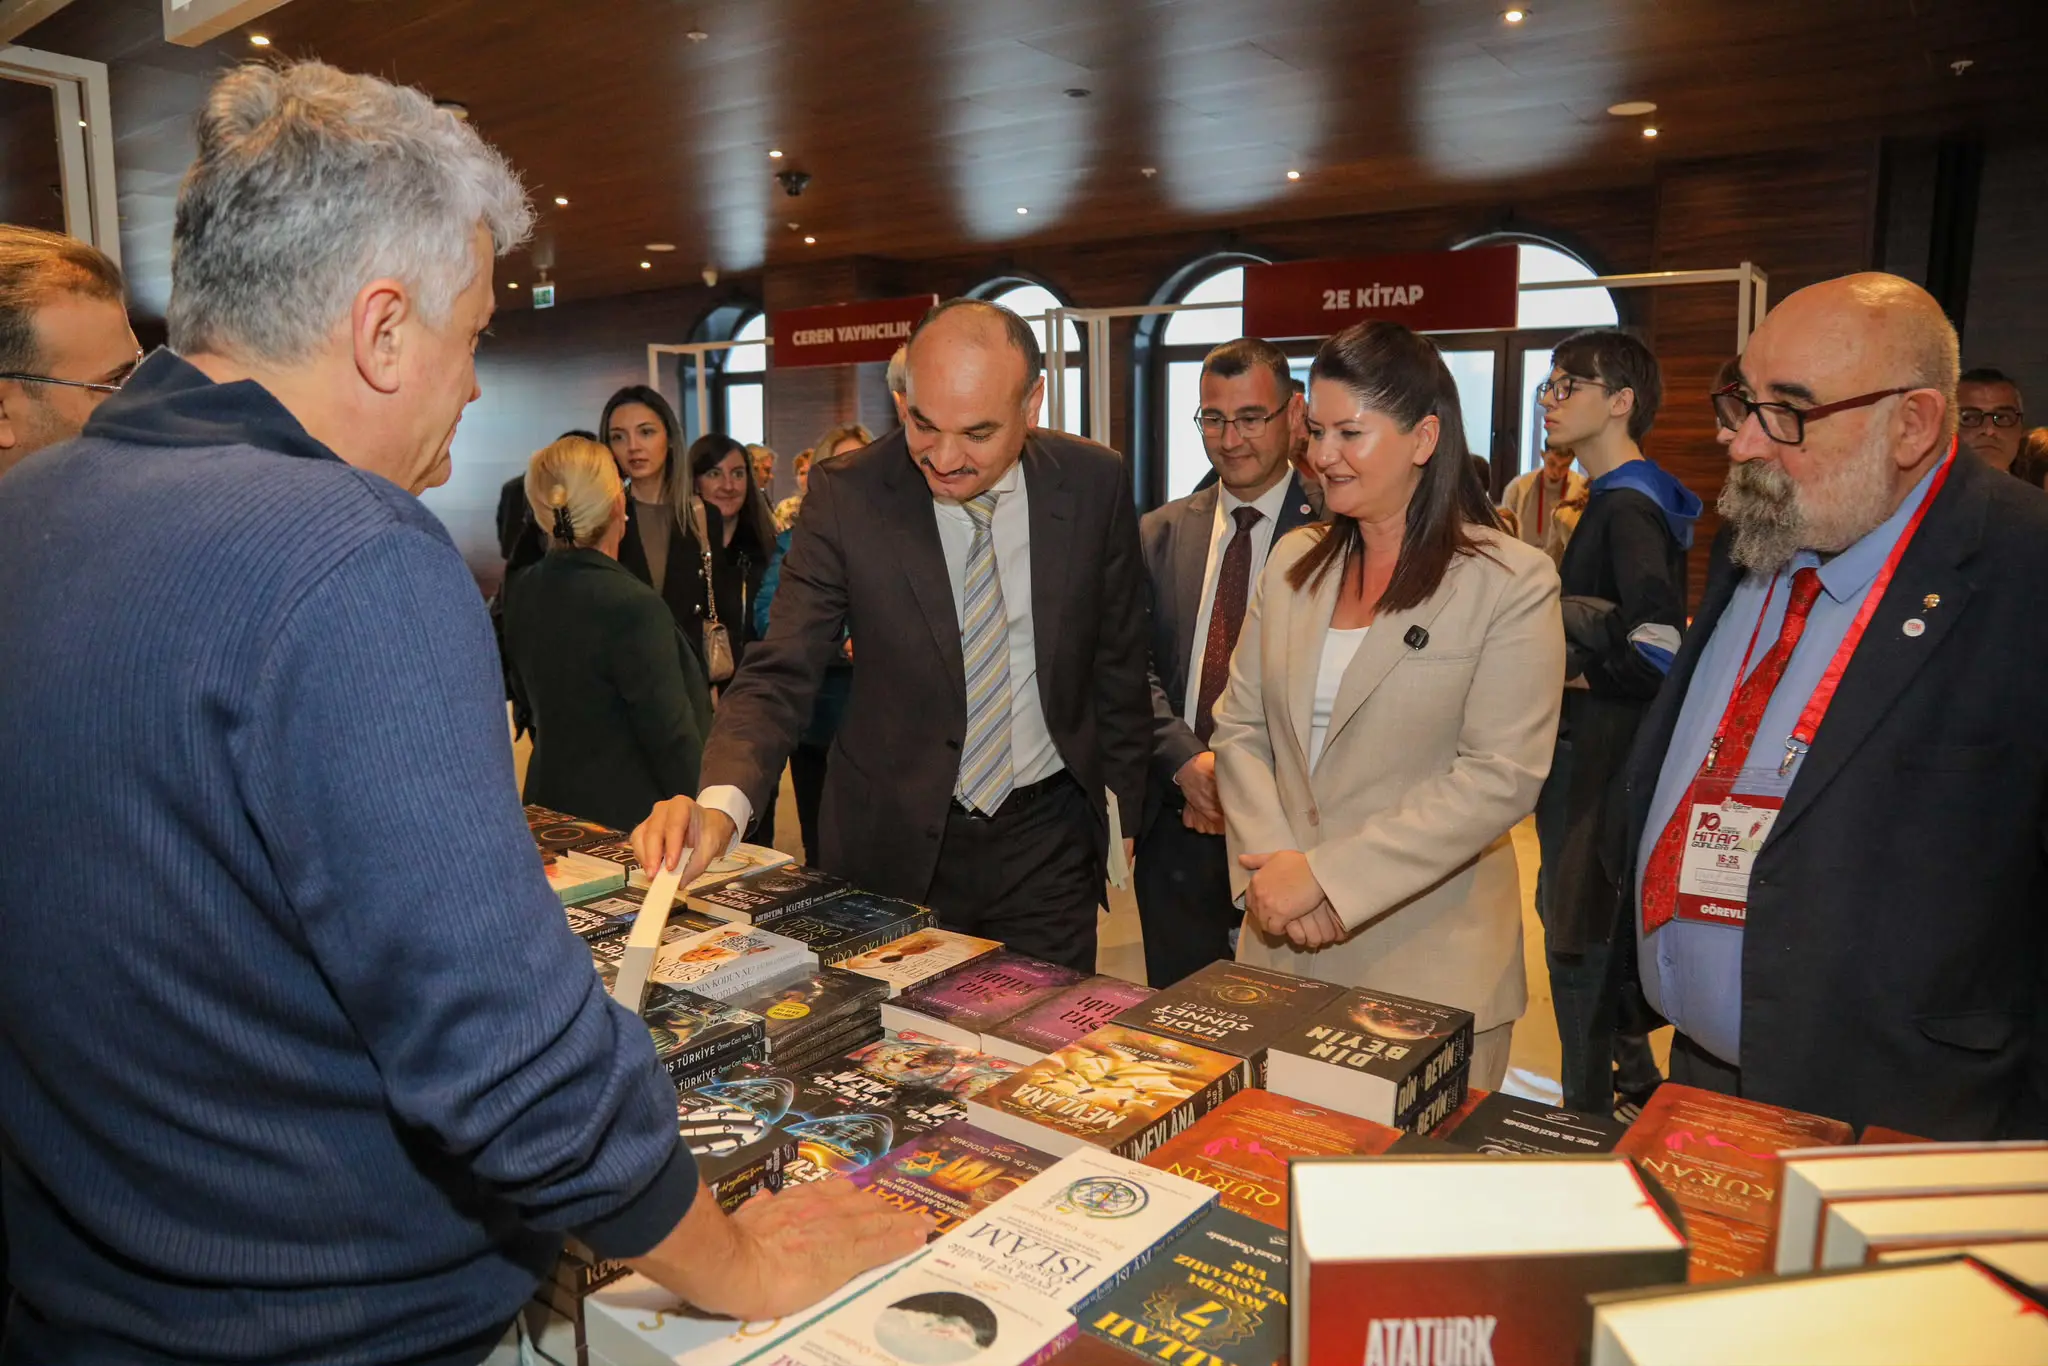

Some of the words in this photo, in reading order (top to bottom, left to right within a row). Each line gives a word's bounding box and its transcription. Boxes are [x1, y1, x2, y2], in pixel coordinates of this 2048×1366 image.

[1322, 289, 1350, 310] 2E
[1356, 282, 1424, 309] KİTAP
[792, 328, 834, 346] CEREN
[836, 321, 912, 342] YAYINCILIK
[1153, 1015, 1229, 1038] HADİS
[1157, 1004, 1254, 1032] SÜNNET
[678, 1045, 715, 1069] TÜRKİYE
[1305, 1027, 1411, 1060] BEYİN
[1308, 1042, 1373, 1068] DİN
[678, 1067, 716, 1092] TÜRKİYE
[1010, 1082, 1128, 1130] MEVLÂNA
[1398, 1075, 1418, 1116] DİN
[1165, 1162, 1281, 1206] QUR'AN
[1641, 1157, 1776, 1201] KUR'AN
[966, 1222, 1095, 1285] İSLÂM
[1180, 1300, 1225, 1328] 7
[1364, 1314, 1498, 1366] ATATÜRK
